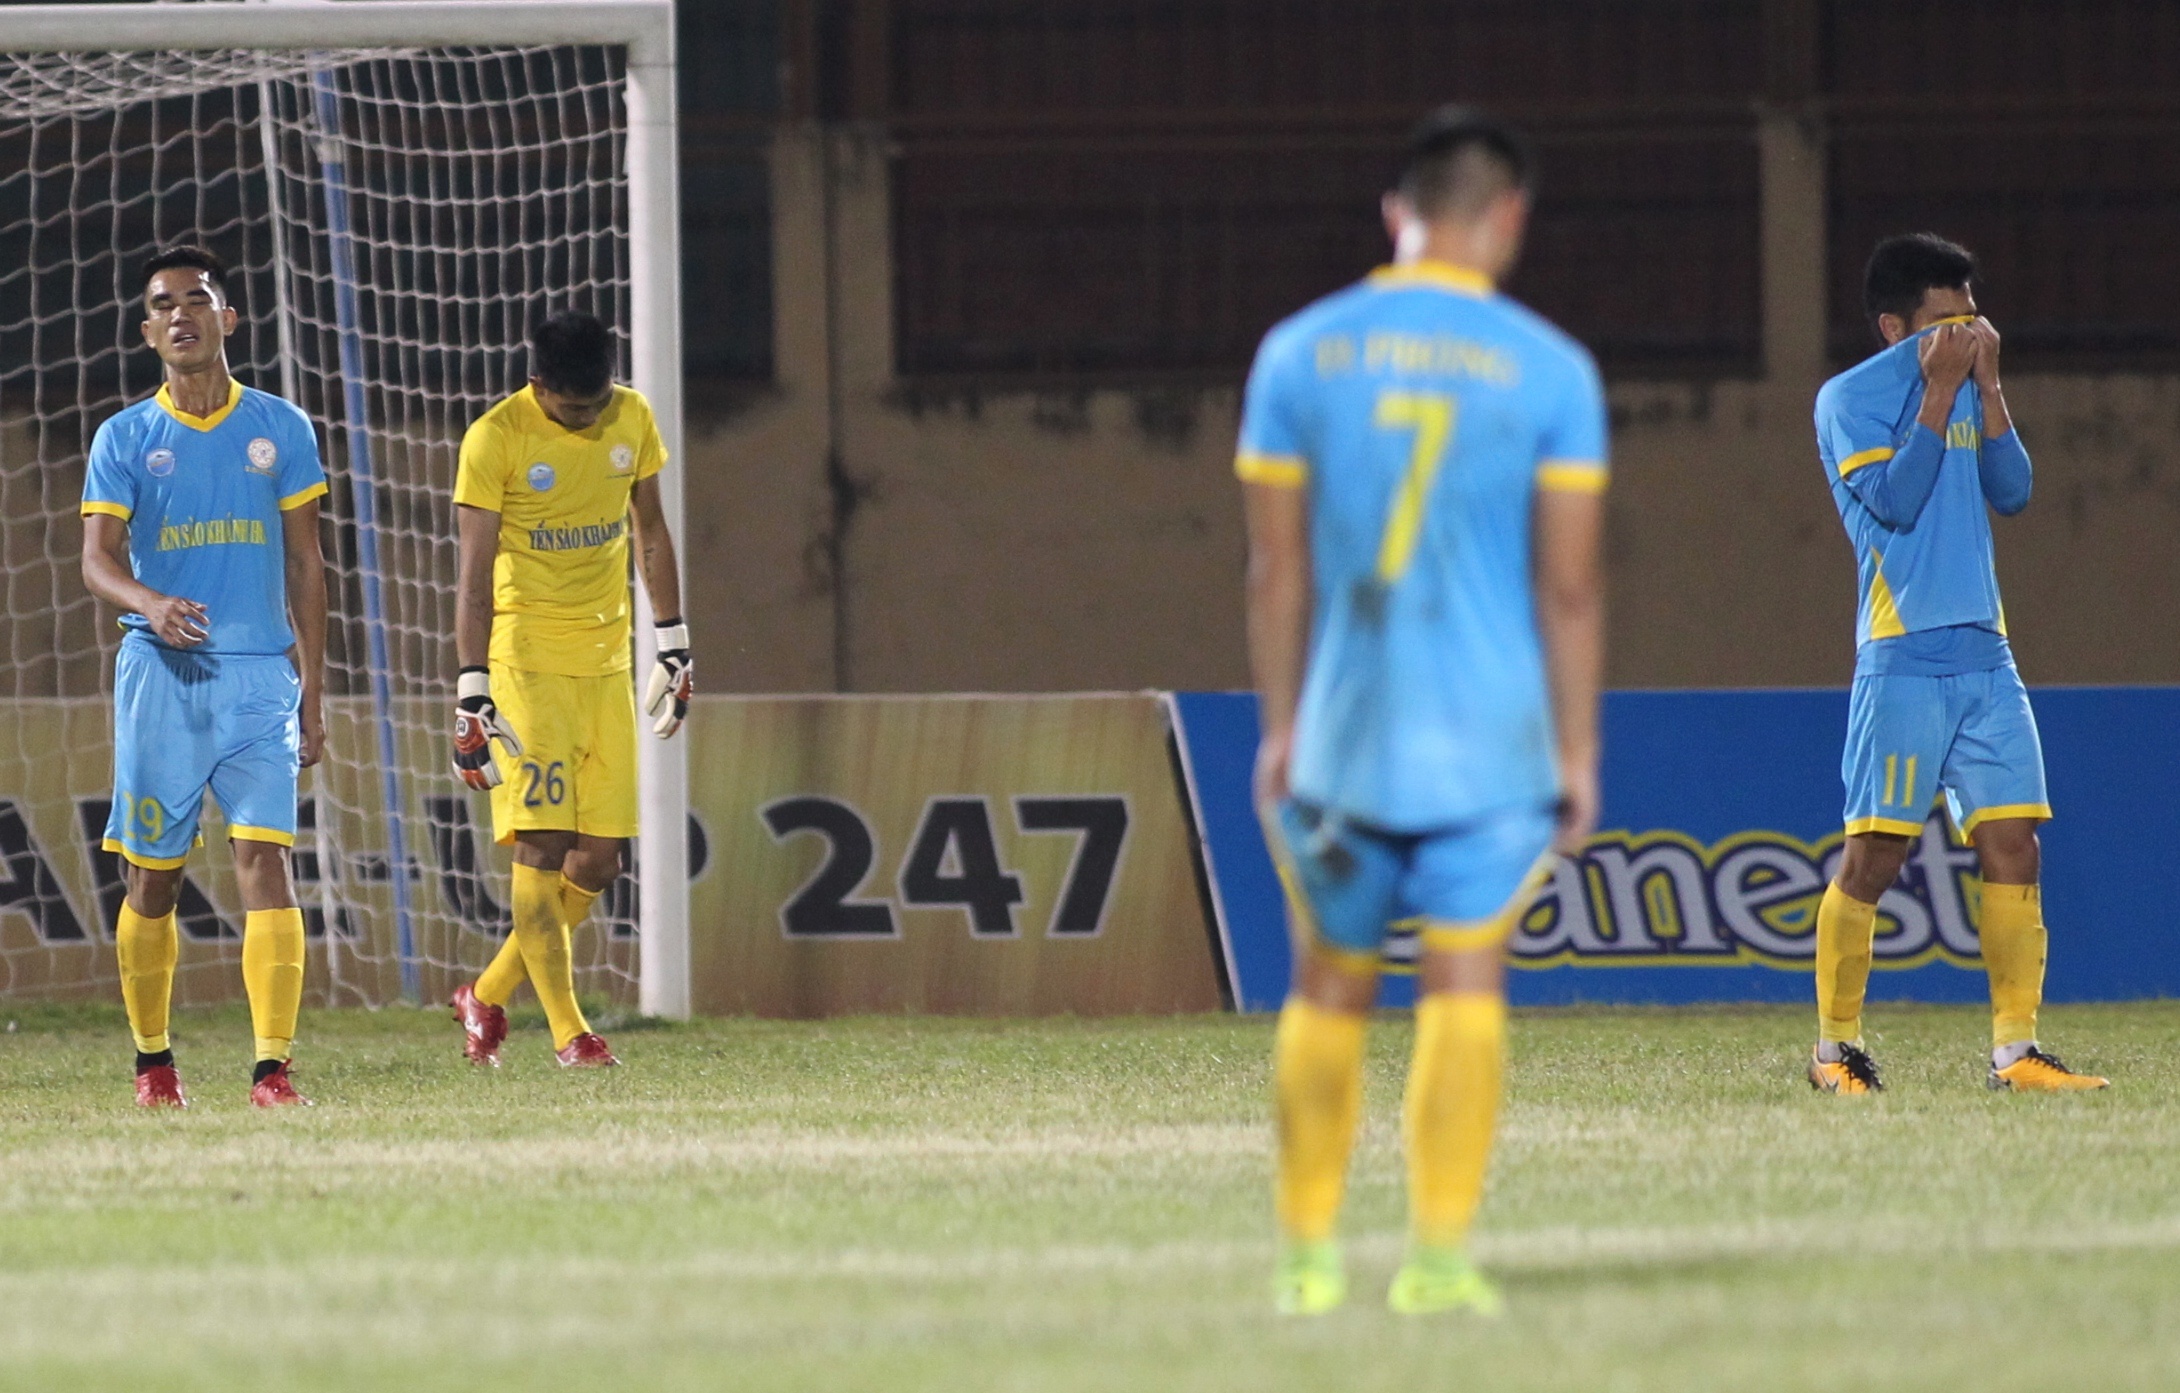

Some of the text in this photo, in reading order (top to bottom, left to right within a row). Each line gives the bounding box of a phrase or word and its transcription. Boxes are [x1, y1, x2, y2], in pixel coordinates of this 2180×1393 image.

[1373, 389, 1457, 584] 7
[521, 761, 564, 807] 26
[1882, 754, 1917, 807] 11
[759, 794, 1131, 939] 247
